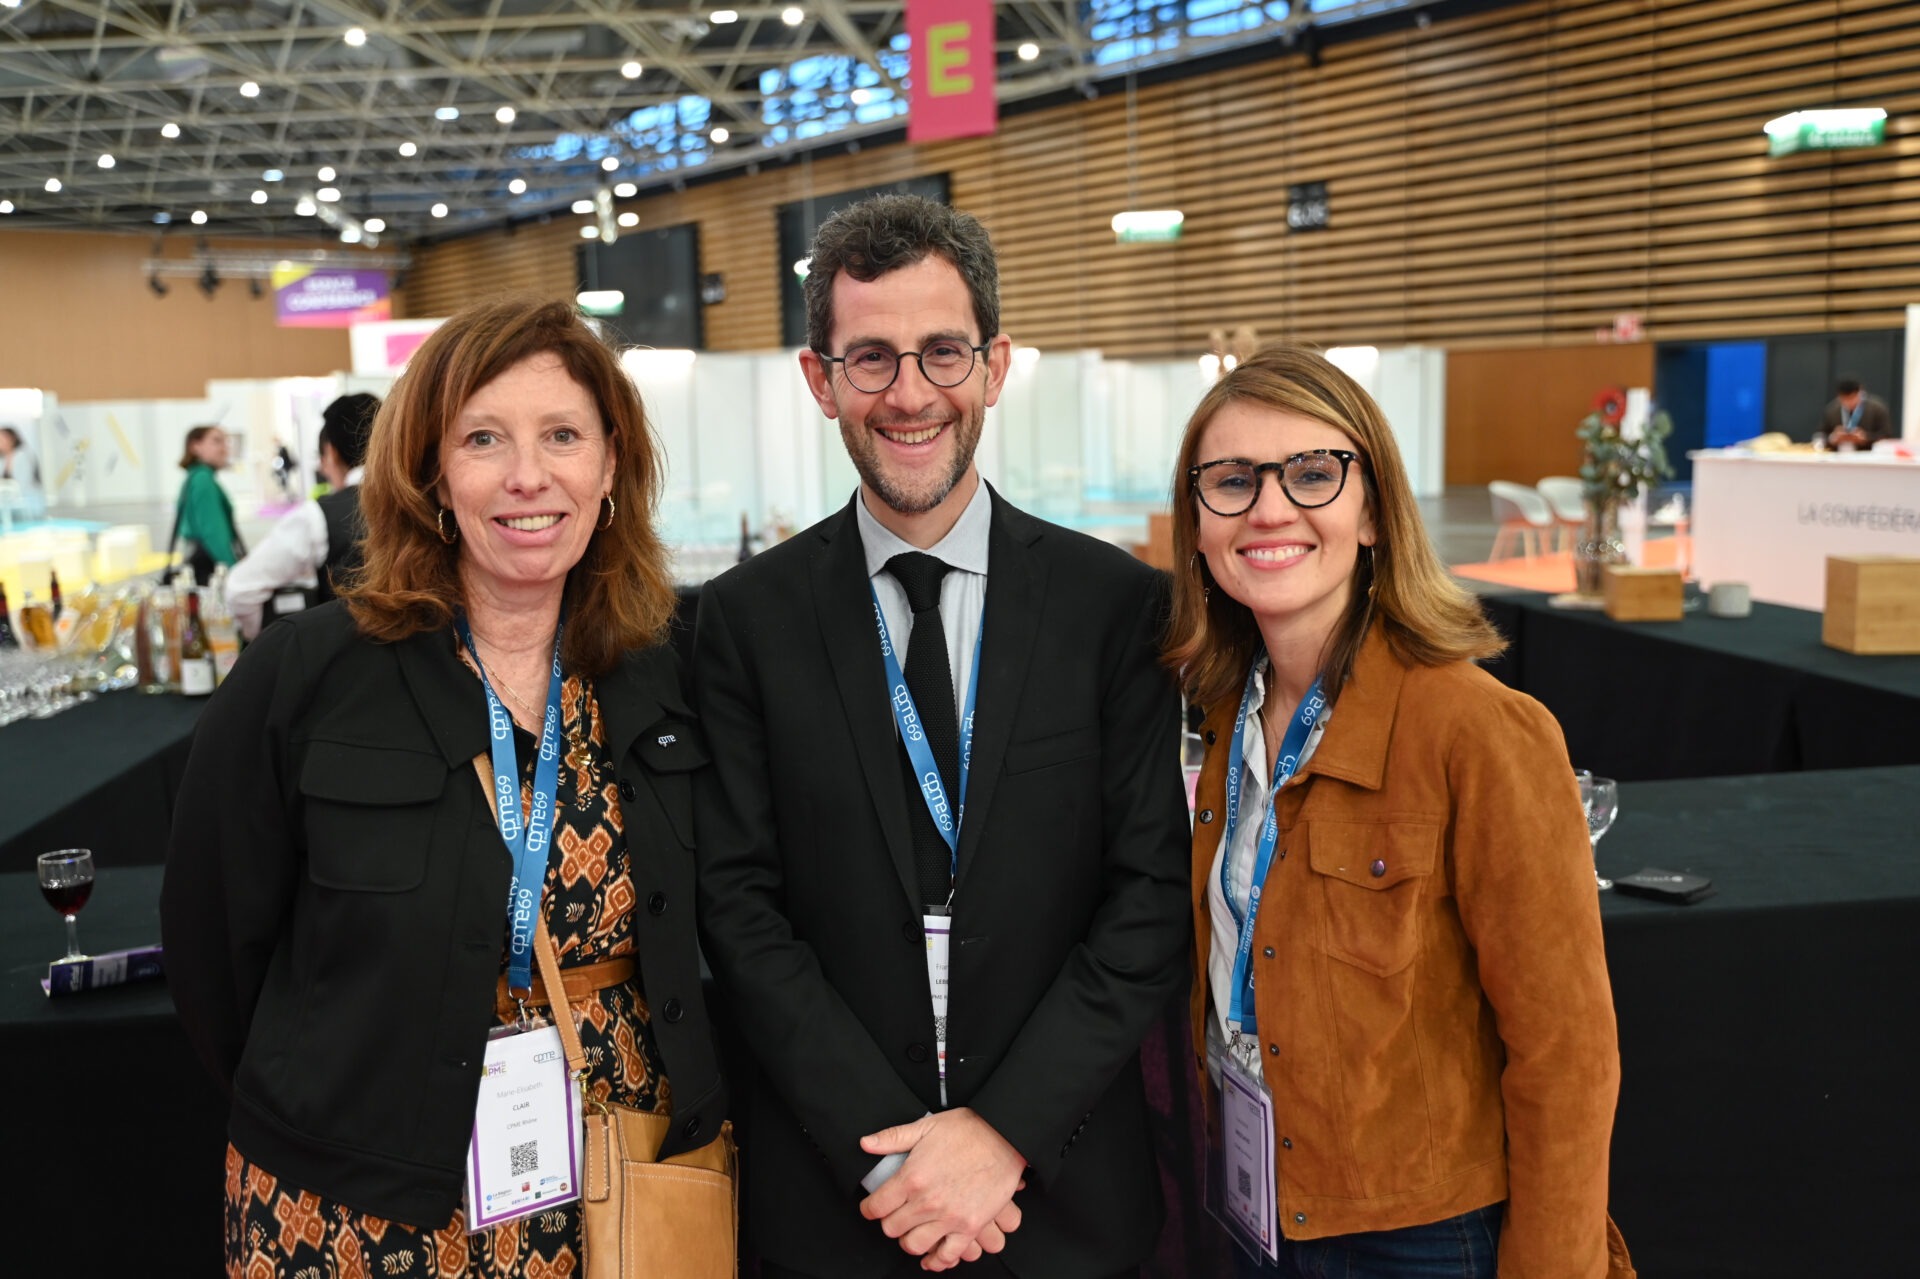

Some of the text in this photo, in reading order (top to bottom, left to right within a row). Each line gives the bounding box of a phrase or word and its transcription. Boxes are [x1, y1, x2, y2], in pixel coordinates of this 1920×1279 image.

[927, 22, 974, 97] E
[540, 705, 558, 761] cpme69
[893, 684, 922, 741] cpme69
[498, 775, 521, 841] cpme69
[527, 791, 548, 852] cpme69
[922, 772, 953, 831] cpme69
[512, 888, 533, 955] cpme69
[533, 1050, 555, 1064] cpme
[513, 1101, 530, 1111] CLAIR
